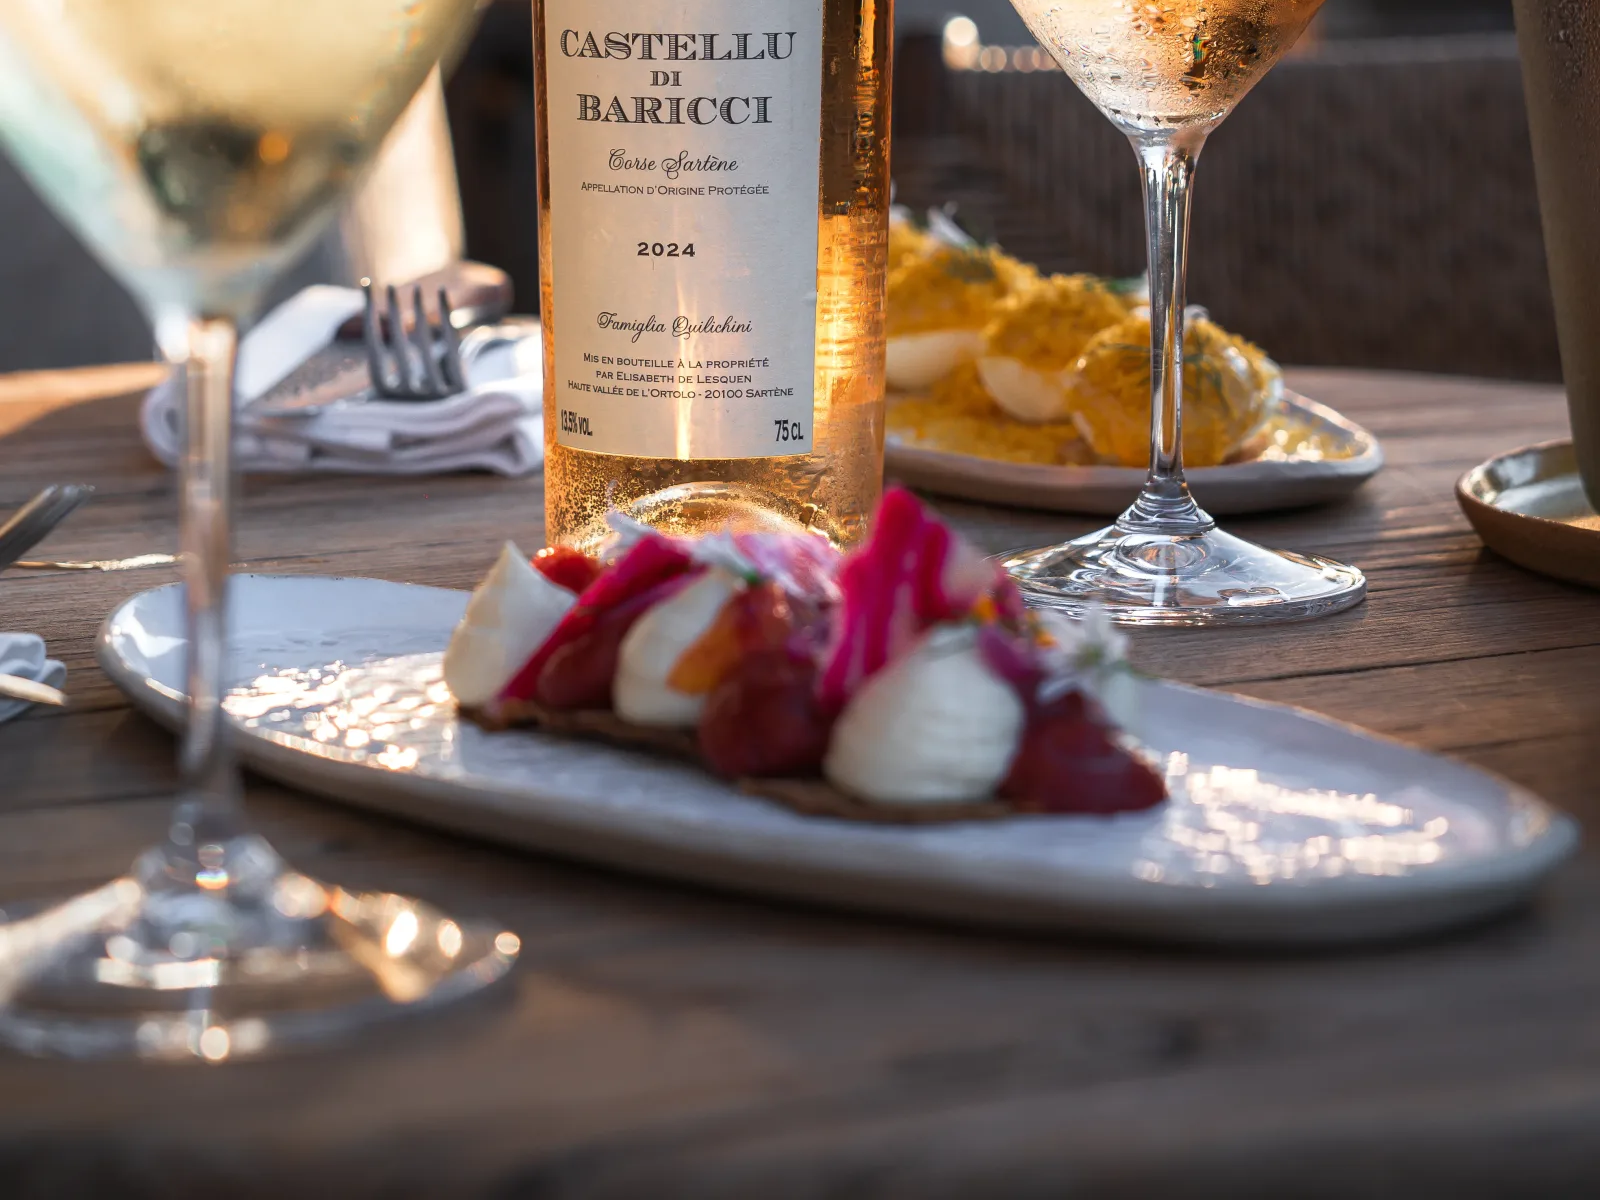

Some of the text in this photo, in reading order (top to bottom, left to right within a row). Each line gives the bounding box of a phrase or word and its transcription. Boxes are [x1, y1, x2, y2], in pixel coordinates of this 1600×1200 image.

[560, 29, 797, 60] CASTELLU
[650, 70, 682, 87] DI
[576, 93, 773, 125] BARICCI
[608, 148, 739, 180] Corse Sartène
[580, 181, 770, 196] APPELLATION D'ORIGINE PROTÉGÉE
[637, 241, 696, 258] 2024
[596, 311, 753, 344] Famiglia Quilichini
[583, 353, 770, 369] MIS EN BOUTEILLE À LA PROPRIÉTÉ
[596, 370, 752, 384] PAR ELISABETH DE LESQUEN
[568, 380, 591, 392] HAUTE
[592, 385, 624, 396] VALLÉE
[626, 388, 640, 397] DE
[642, 388, 696, 399] L'ORTOLO
[704, 389, 743, 399] 20100
[745, 386, 794, 398] SARTÈNE
[560, 408, 593, 436] 13,5% VOL.
[774, 419, 804, 442] 75 CL
